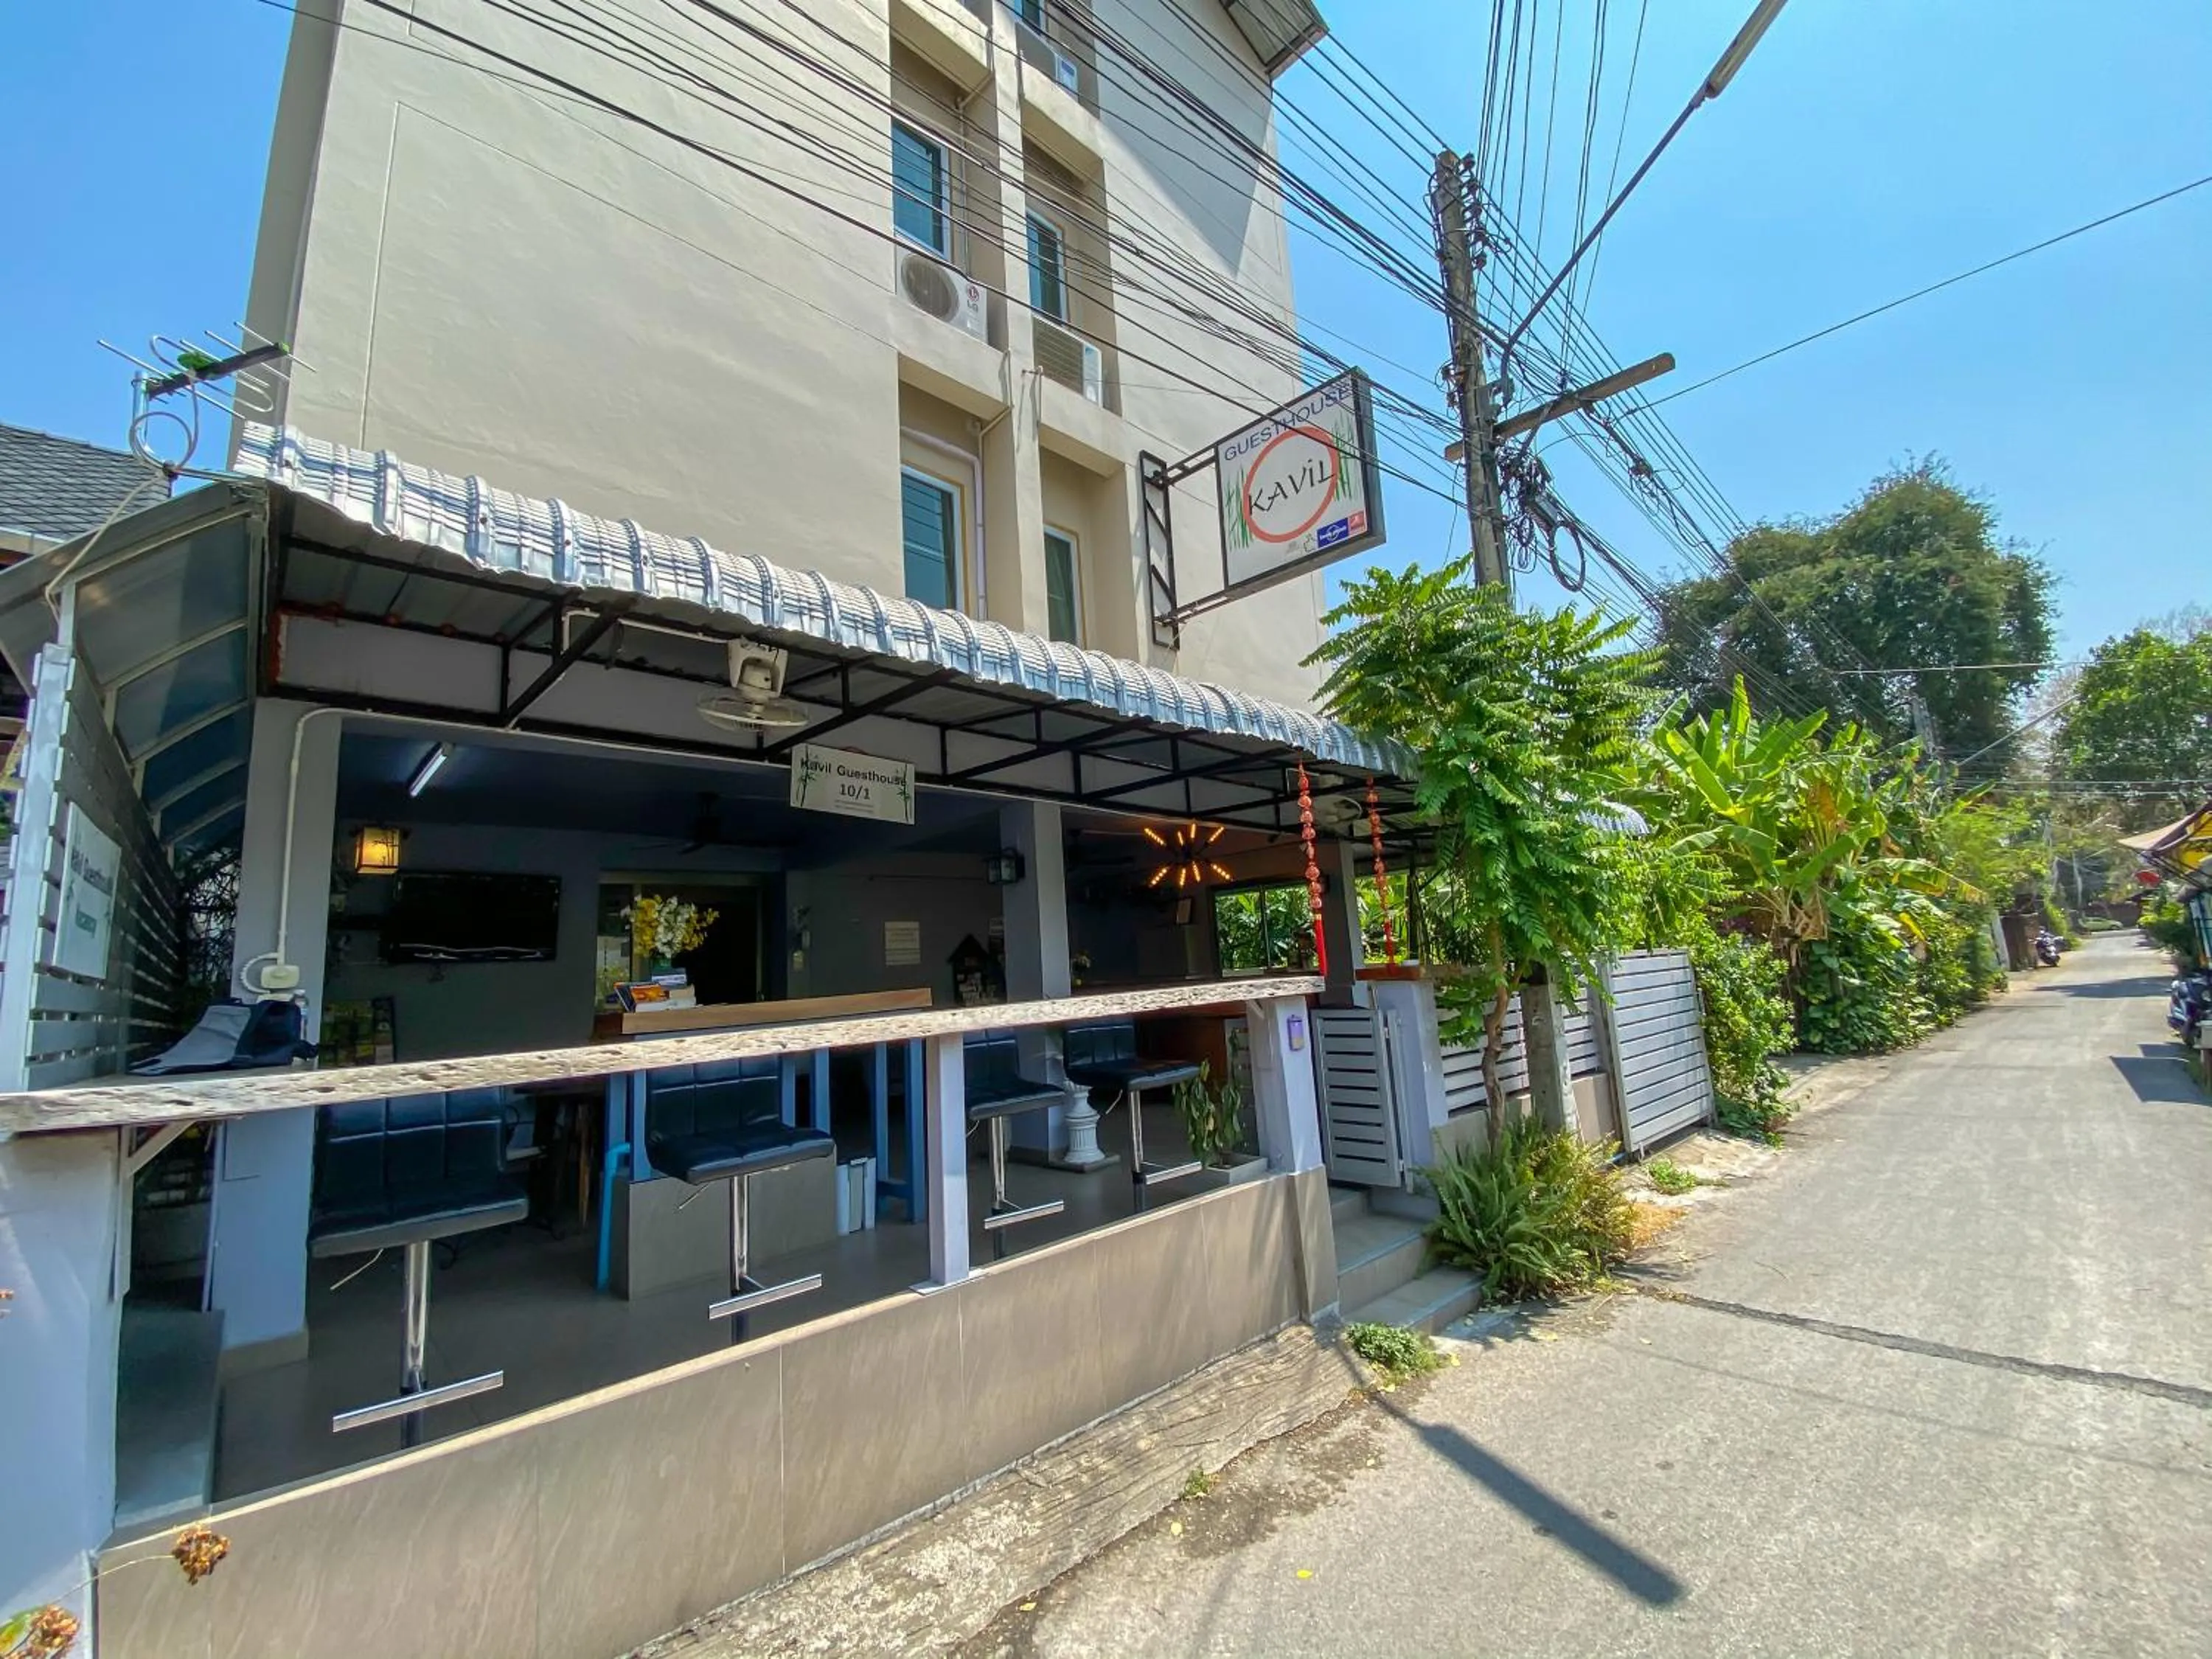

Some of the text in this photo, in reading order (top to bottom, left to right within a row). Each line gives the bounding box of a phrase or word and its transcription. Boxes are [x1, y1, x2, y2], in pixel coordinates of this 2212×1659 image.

[1225, 386, 1353, 461] GUESTHOUSE
[801, 757, 907, 787] Kavil Guesthouse
[840, 784, 871, 800] 10/1
